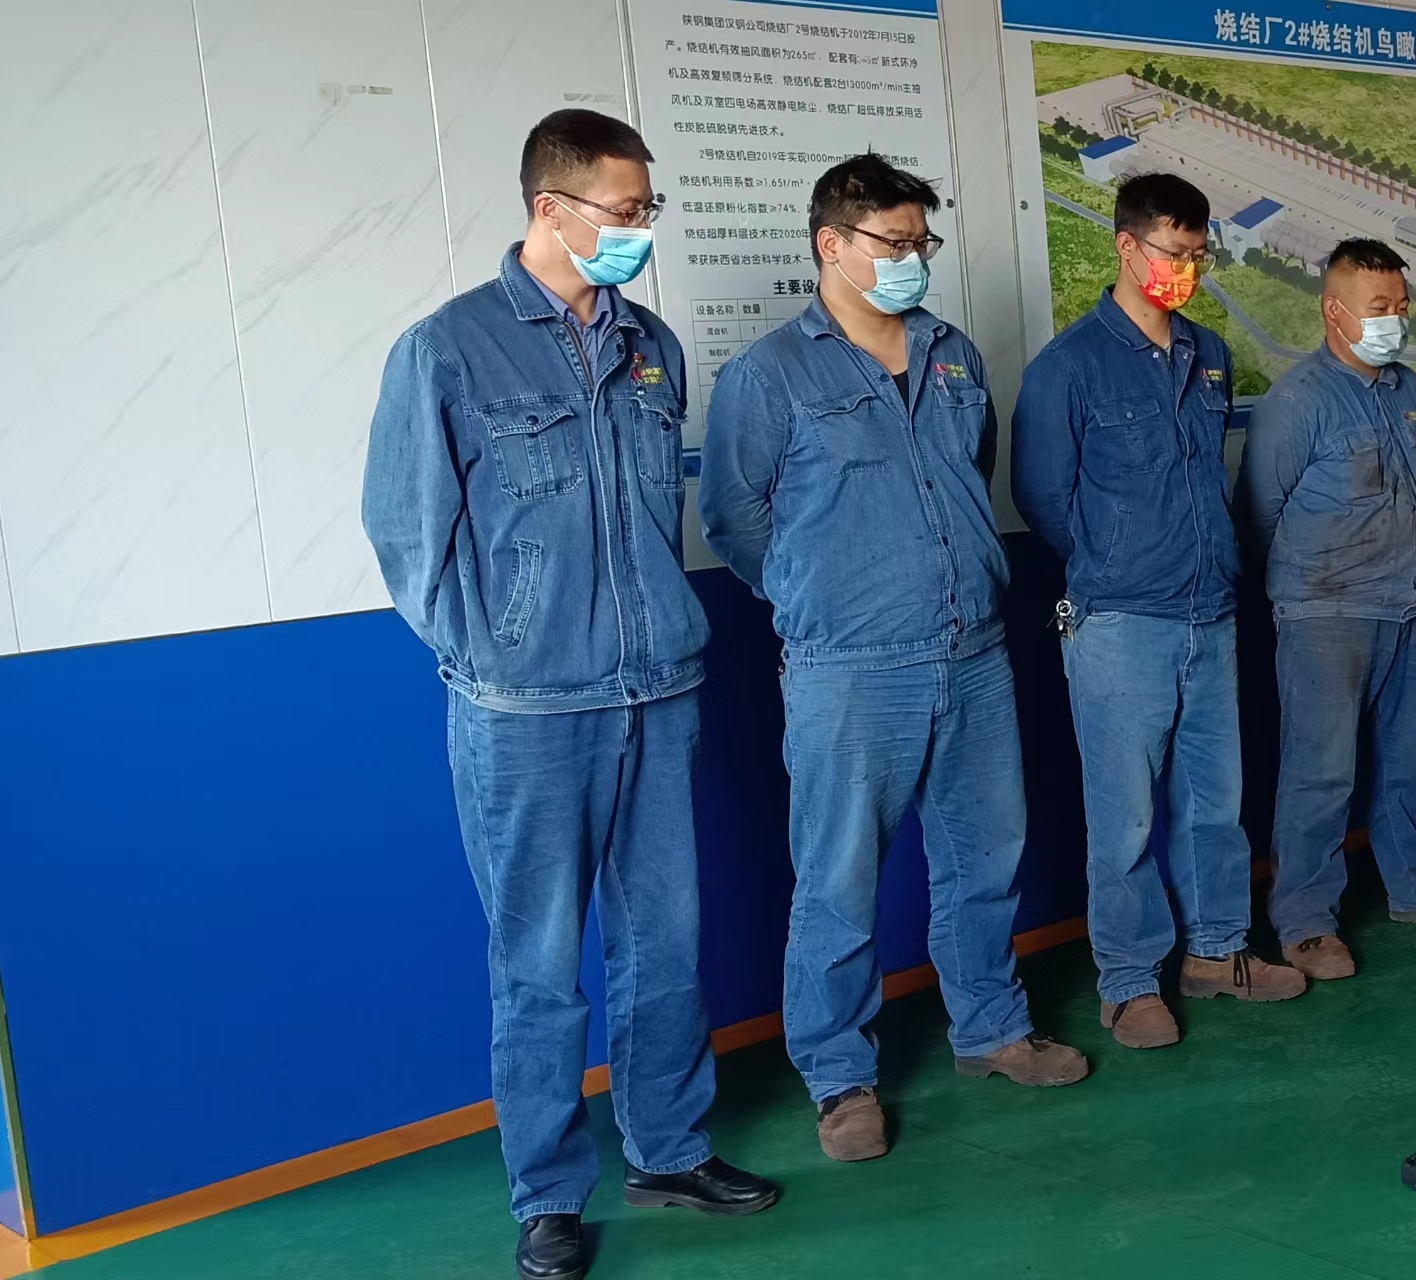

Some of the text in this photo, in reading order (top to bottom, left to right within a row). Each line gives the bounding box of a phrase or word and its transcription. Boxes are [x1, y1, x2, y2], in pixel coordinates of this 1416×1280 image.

[685, 227, 811, 240] 烧结超厚料层技术在2020年
[773, 279, 816, 296] 主要设
[696, 303, 761, 316] 设备名称 数量
